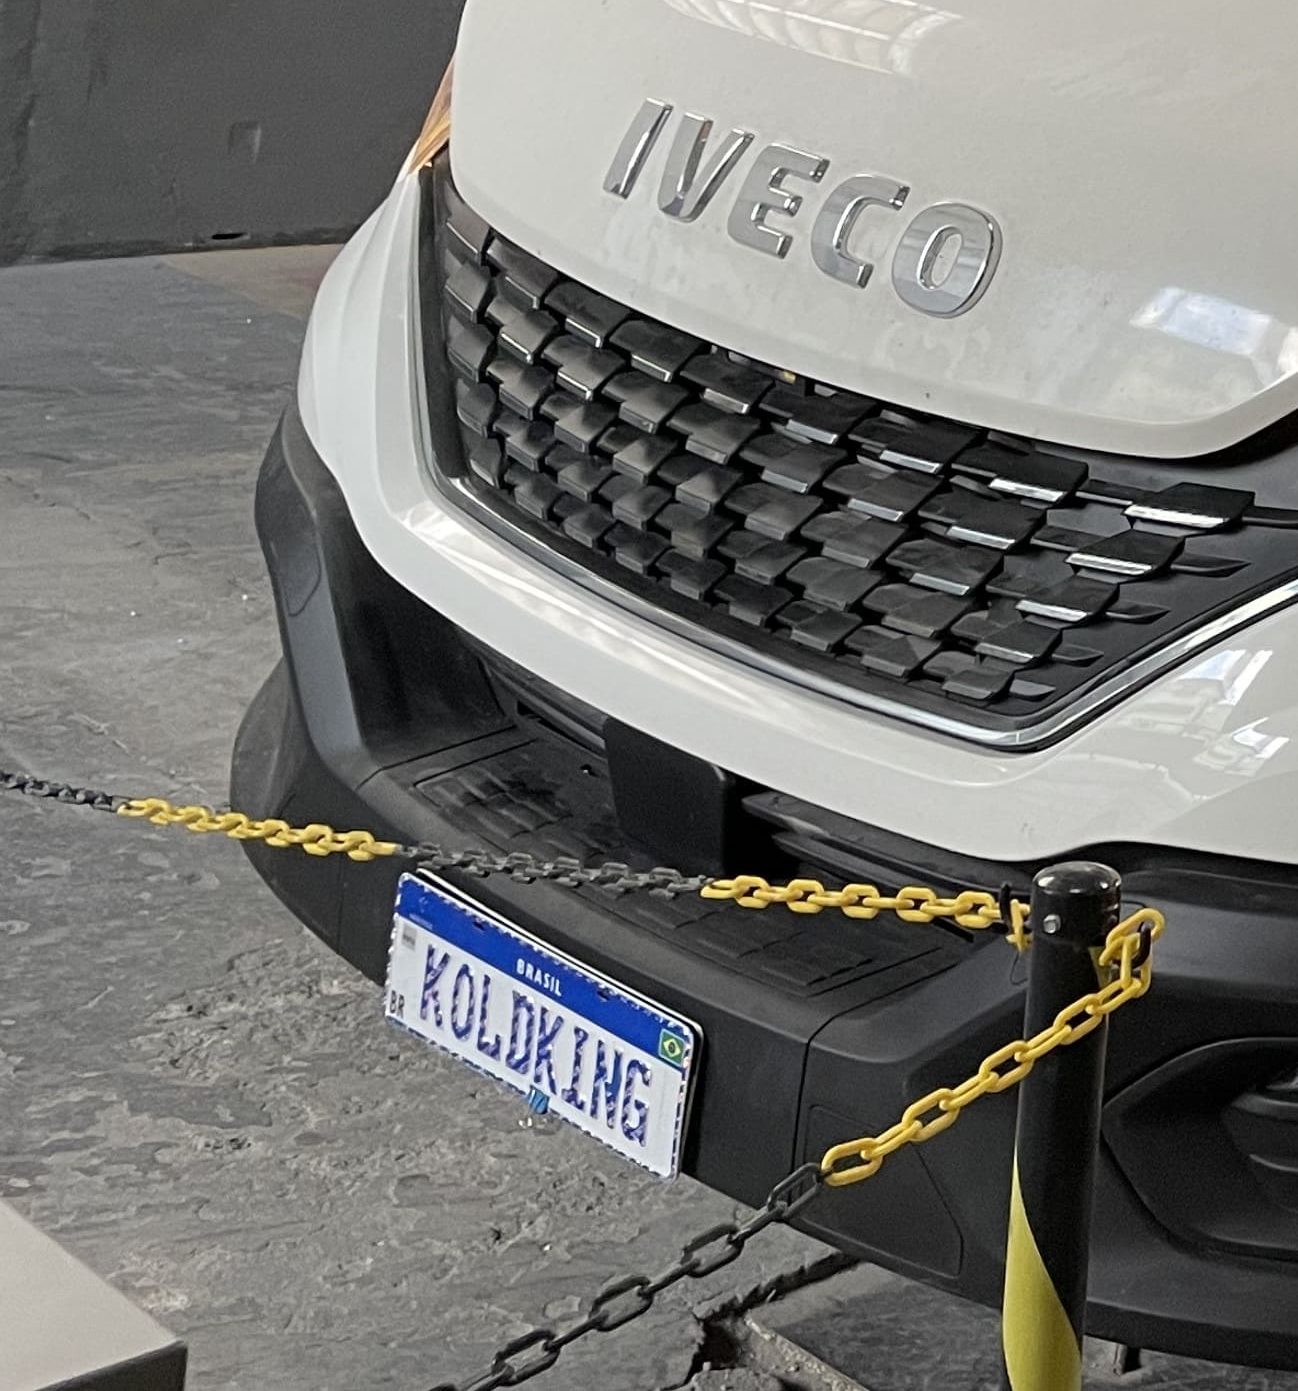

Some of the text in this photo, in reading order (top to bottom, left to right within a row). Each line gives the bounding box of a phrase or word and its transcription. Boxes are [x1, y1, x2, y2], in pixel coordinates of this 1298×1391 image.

[603, 97, 1003, 319] IVECO
[389, 990, 404, 1018] BR
[516, 958, 562, 997] BRASIL
[420, 944, 652, 1147] KOLDKING
